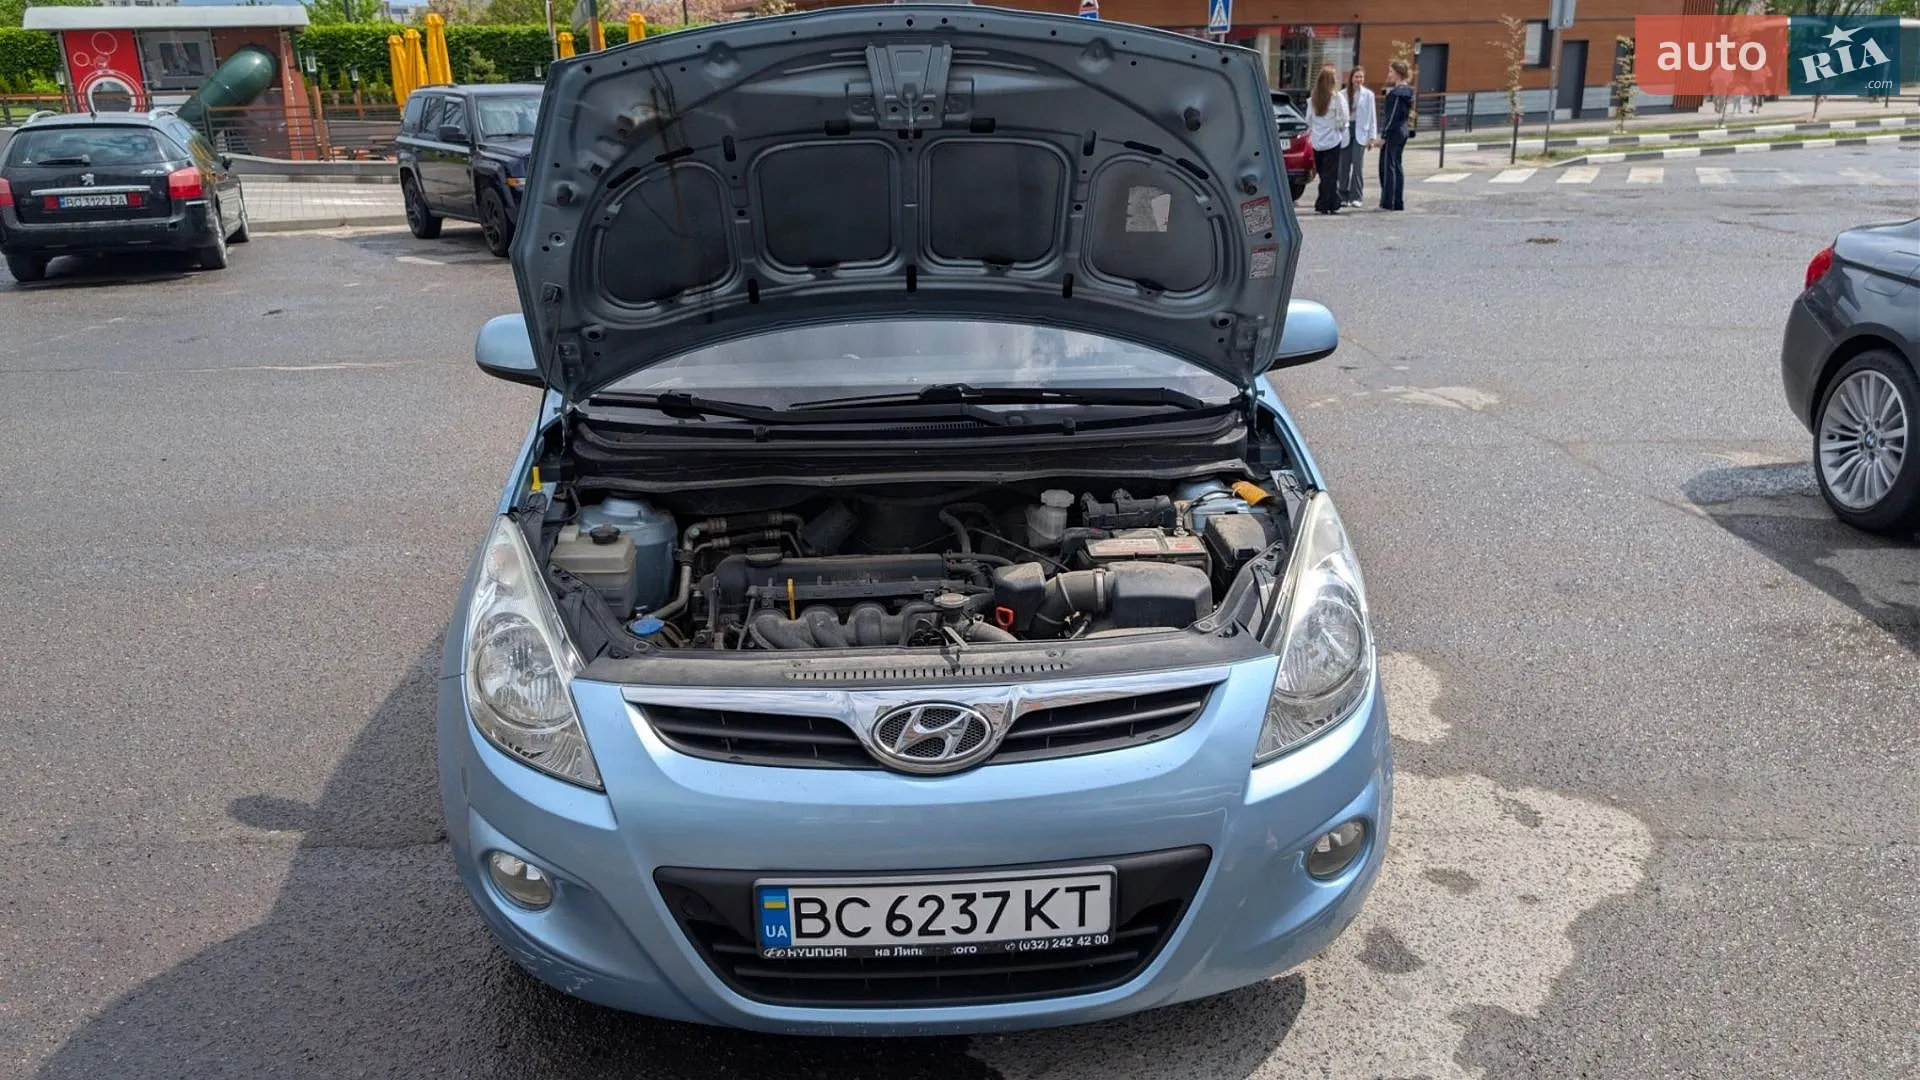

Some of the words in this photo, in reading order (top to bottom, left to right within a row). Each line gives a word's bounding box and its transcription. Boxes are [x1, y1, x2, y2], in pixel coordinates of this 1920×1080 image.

[793, 896, 872, 939] BC
[885, 890, 1011, 937] 6237
[1024, 884, 1101, 932] KT
[765, 924, 788, 938] UA
[787, 947, 847, 958] HYUNDAI
[875, 948, 890, 957] на
[1052, 937, 1073, 948] 242
[1077, 936, 1091, 946] 42
[1094, 934, 1109, 945] 00
